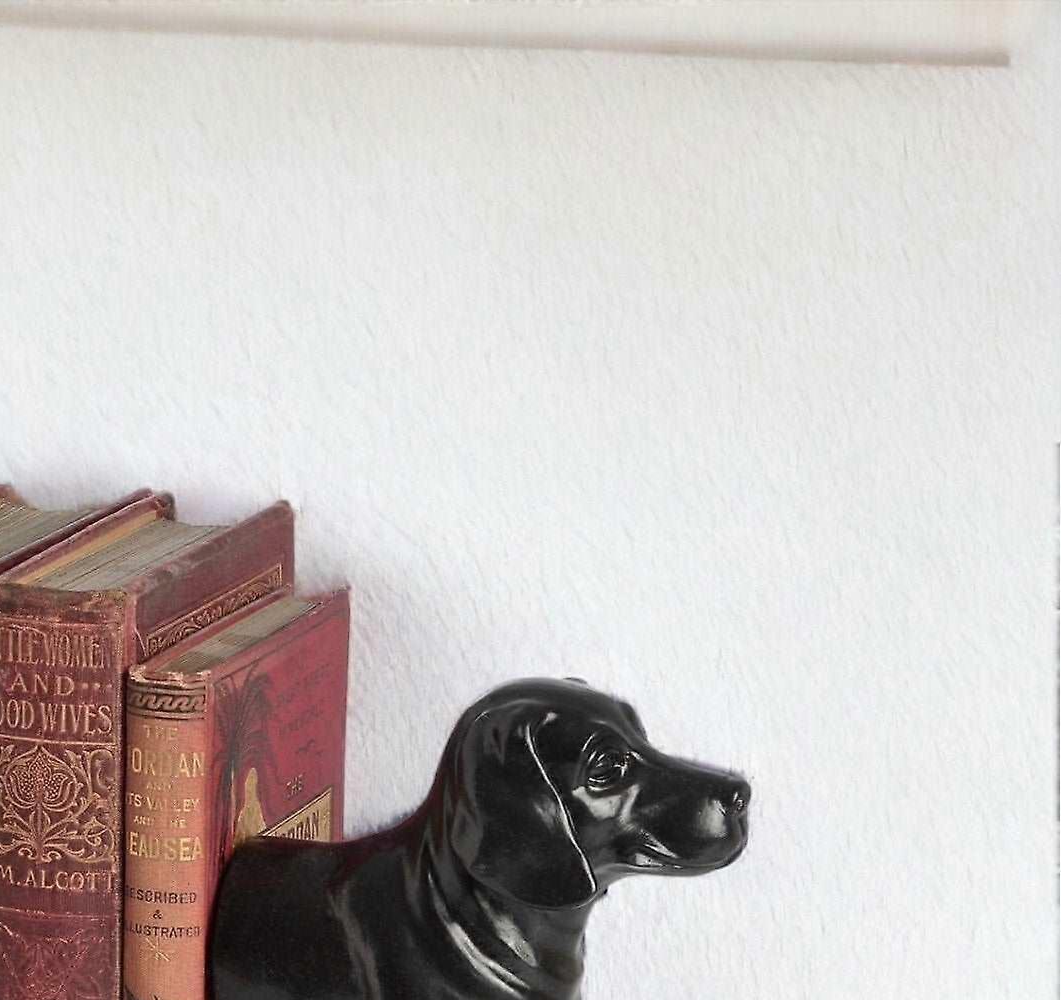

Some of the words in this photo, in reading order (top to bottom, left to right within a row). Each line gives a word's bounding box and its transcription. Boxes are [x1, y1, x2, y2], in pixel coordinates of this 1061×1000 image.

[10, 673, 75, 697] AND
[40, 701, 113, 736] WIVES
[130, 747, 205, 778] ORDAN
[124, 791, 143, 808] TS
[127, 830, 160, 859] EAD
[152, 908, 163, 920] &
